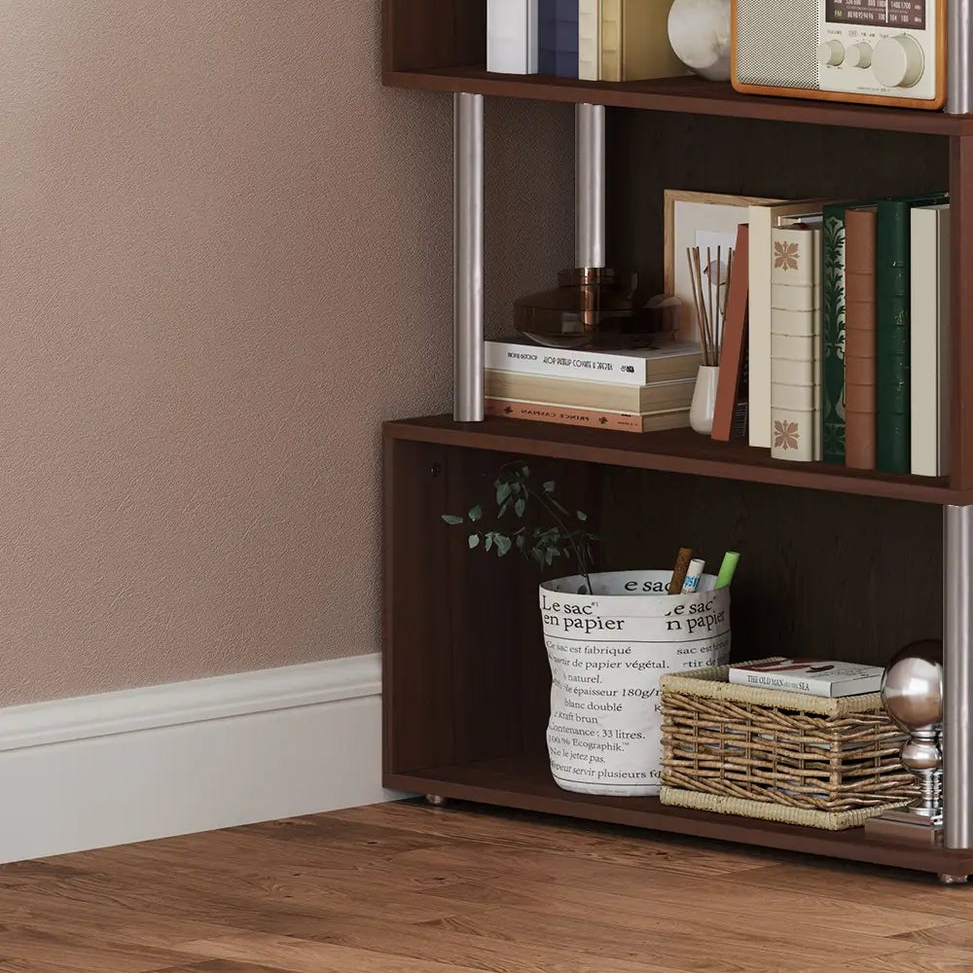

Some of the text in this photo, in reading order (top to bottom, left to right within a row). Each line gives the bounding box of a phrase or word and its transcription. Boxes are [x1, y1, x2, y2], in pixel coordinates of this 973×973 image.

[542, 594, 560, 612] Le
[544, 614, 625, 634] en papier
[686, 610, 725, 634] papier
[569, 646, 582, 654] est
[584, 645, 632, 657] fabriqué
[676, 647, 697, 655] sac
[571, 658, 584, 667] de
[585, 659, 622, 671] papier
[625, 660, 670, 672] végétal.
[568, 674, 603, 684] naturel.
[759, 676, 771, 685] OLD
[771, 678, 784, 687] MAN
[799, 681, 810, 691] SEA
[573, 687, 618, 697] épaisseur
[564, 698, 623, 712] blanc doublé
[559, 711, 574, 721] kraft
[575, 713, 598, 724] brun
[602, 729, 613, 739] 33
[615, 729, 646, 740] litres.
[562, 748, 569, 758] le
[570, 750, 588, 761] jetez
[589, 755, 606, 765] pas.
[573, 767, 595, 777] servir
[597, 769, 647, 779] plusieurs
